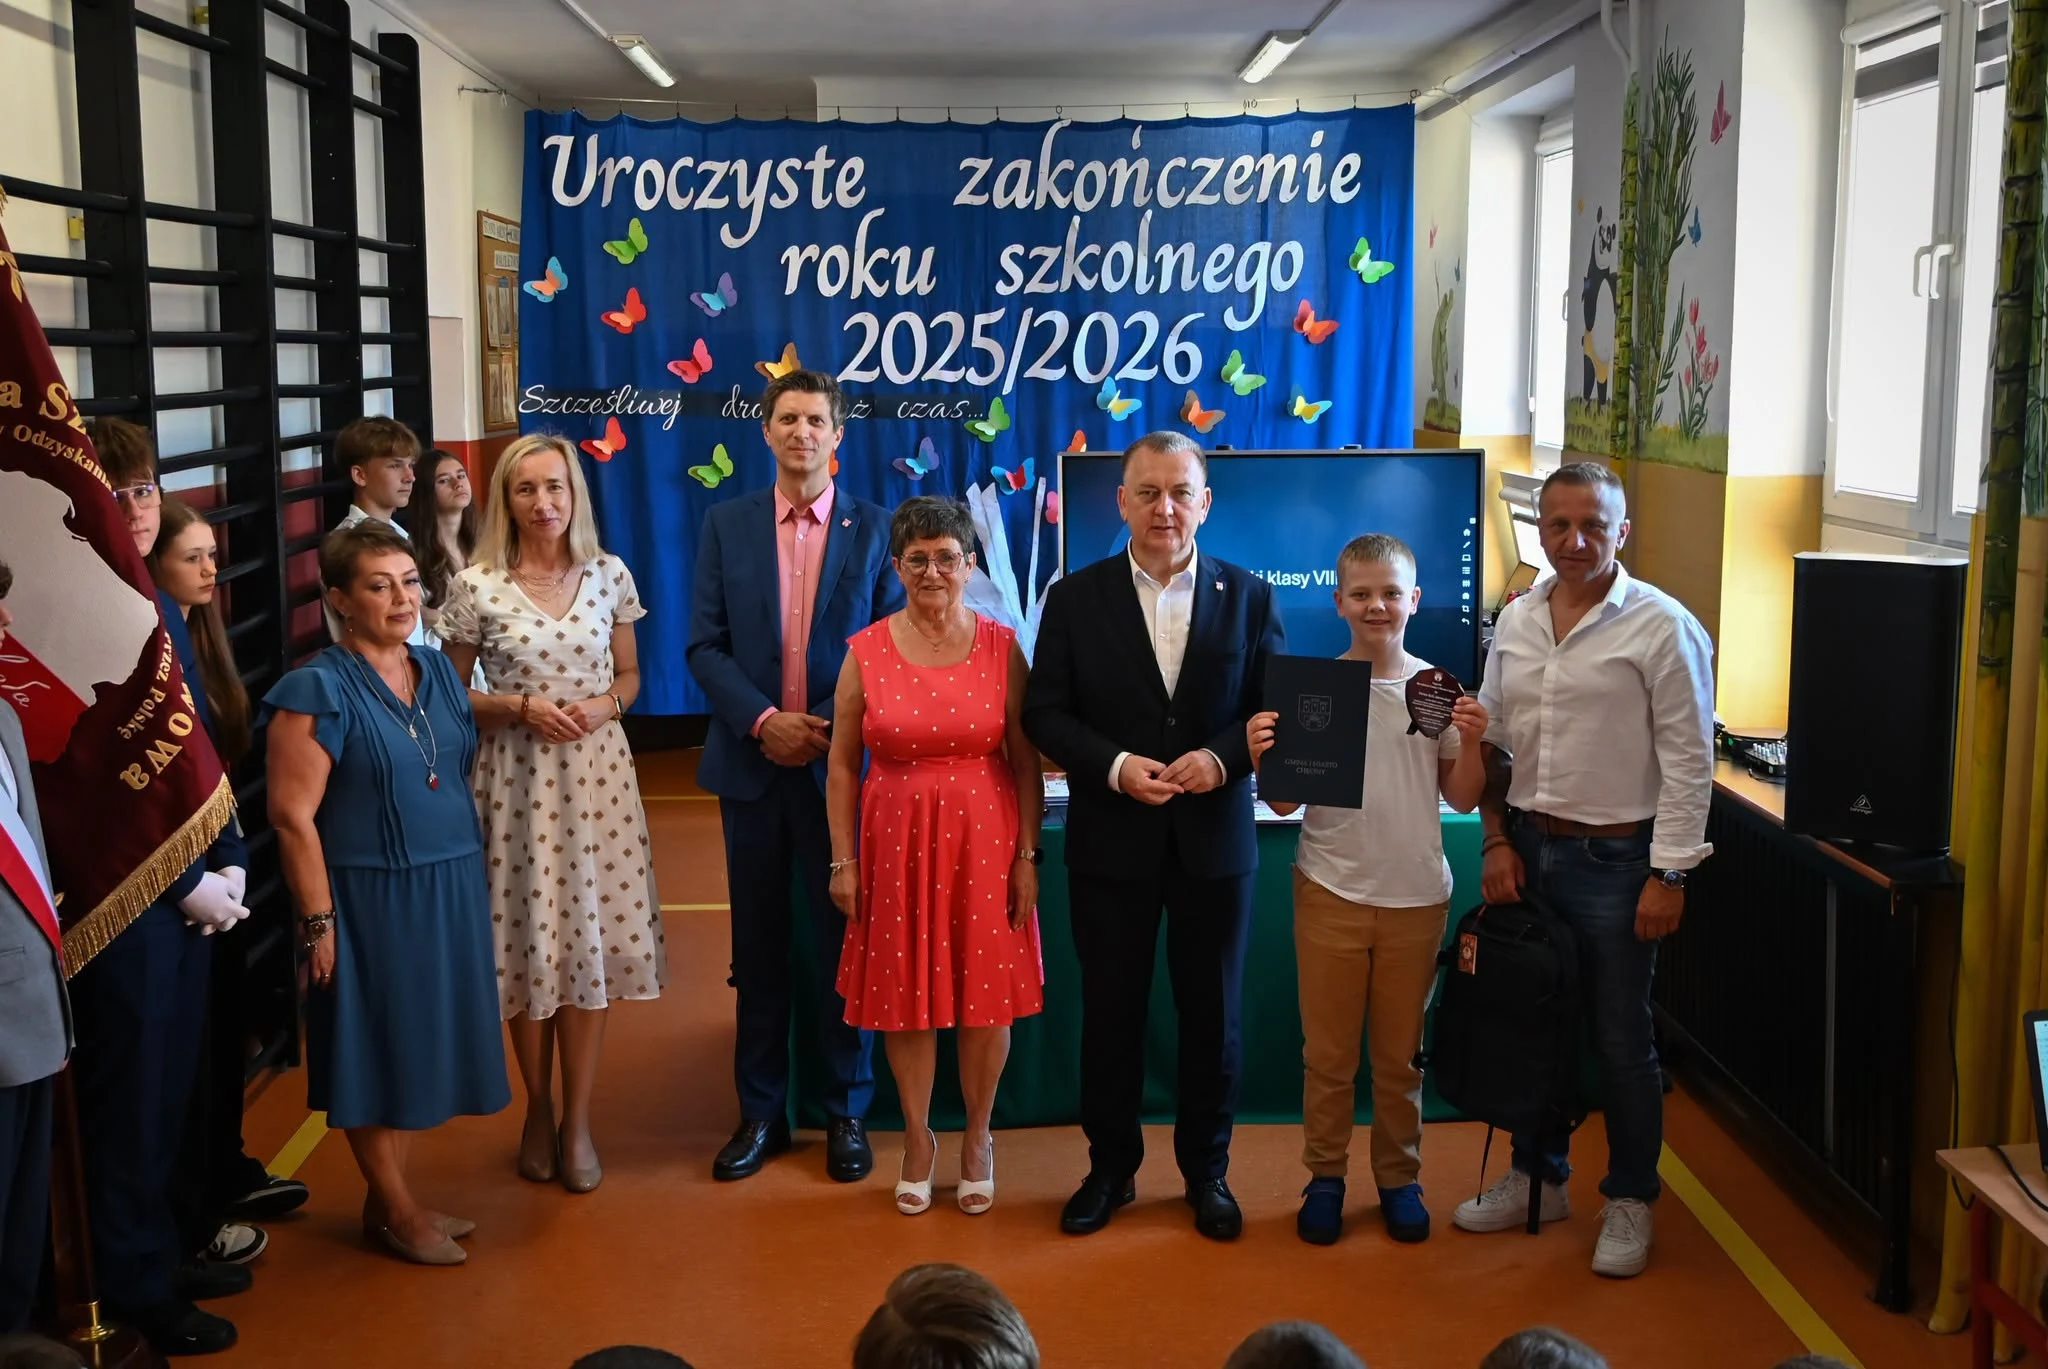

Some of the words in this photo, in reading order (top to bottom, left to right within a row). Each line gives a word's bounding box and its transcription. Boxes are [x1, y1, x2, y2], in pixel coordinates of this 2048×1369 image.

[543, 133, 866, 249] Uroczyste
[953, 118, 1362, 212] zakończenie
[781, 207, 936, 299] roku
[995, 209, 1305, 331] szkolnego
[837, 307, 1206, 395] 2025/2026
[518, 384, 684, 431] Szczęśliwej
[721, 384, 763, 419] dro
[897, 399, 985, 419] czas...
[1267, 569, 1310, 589] klasy
[117, 686, 167, 740] Polskę
